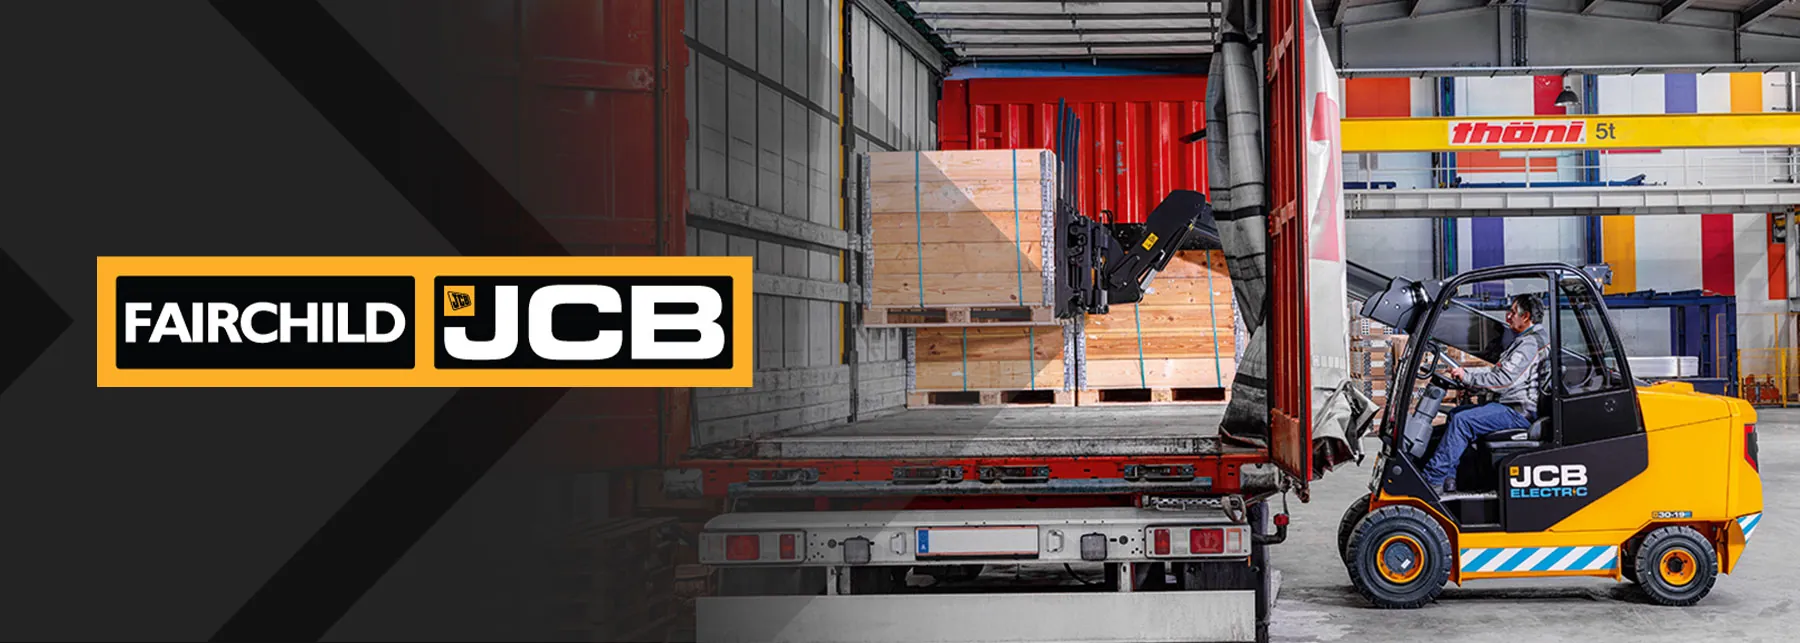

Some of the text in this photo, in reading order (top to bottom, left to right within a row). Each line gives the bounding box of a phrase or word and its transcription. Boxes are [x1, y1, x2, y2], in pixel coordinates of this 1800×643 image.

[1452, 121, 1616, 143] thöni 5t
[1510, 465, 1588, 488] JCB
